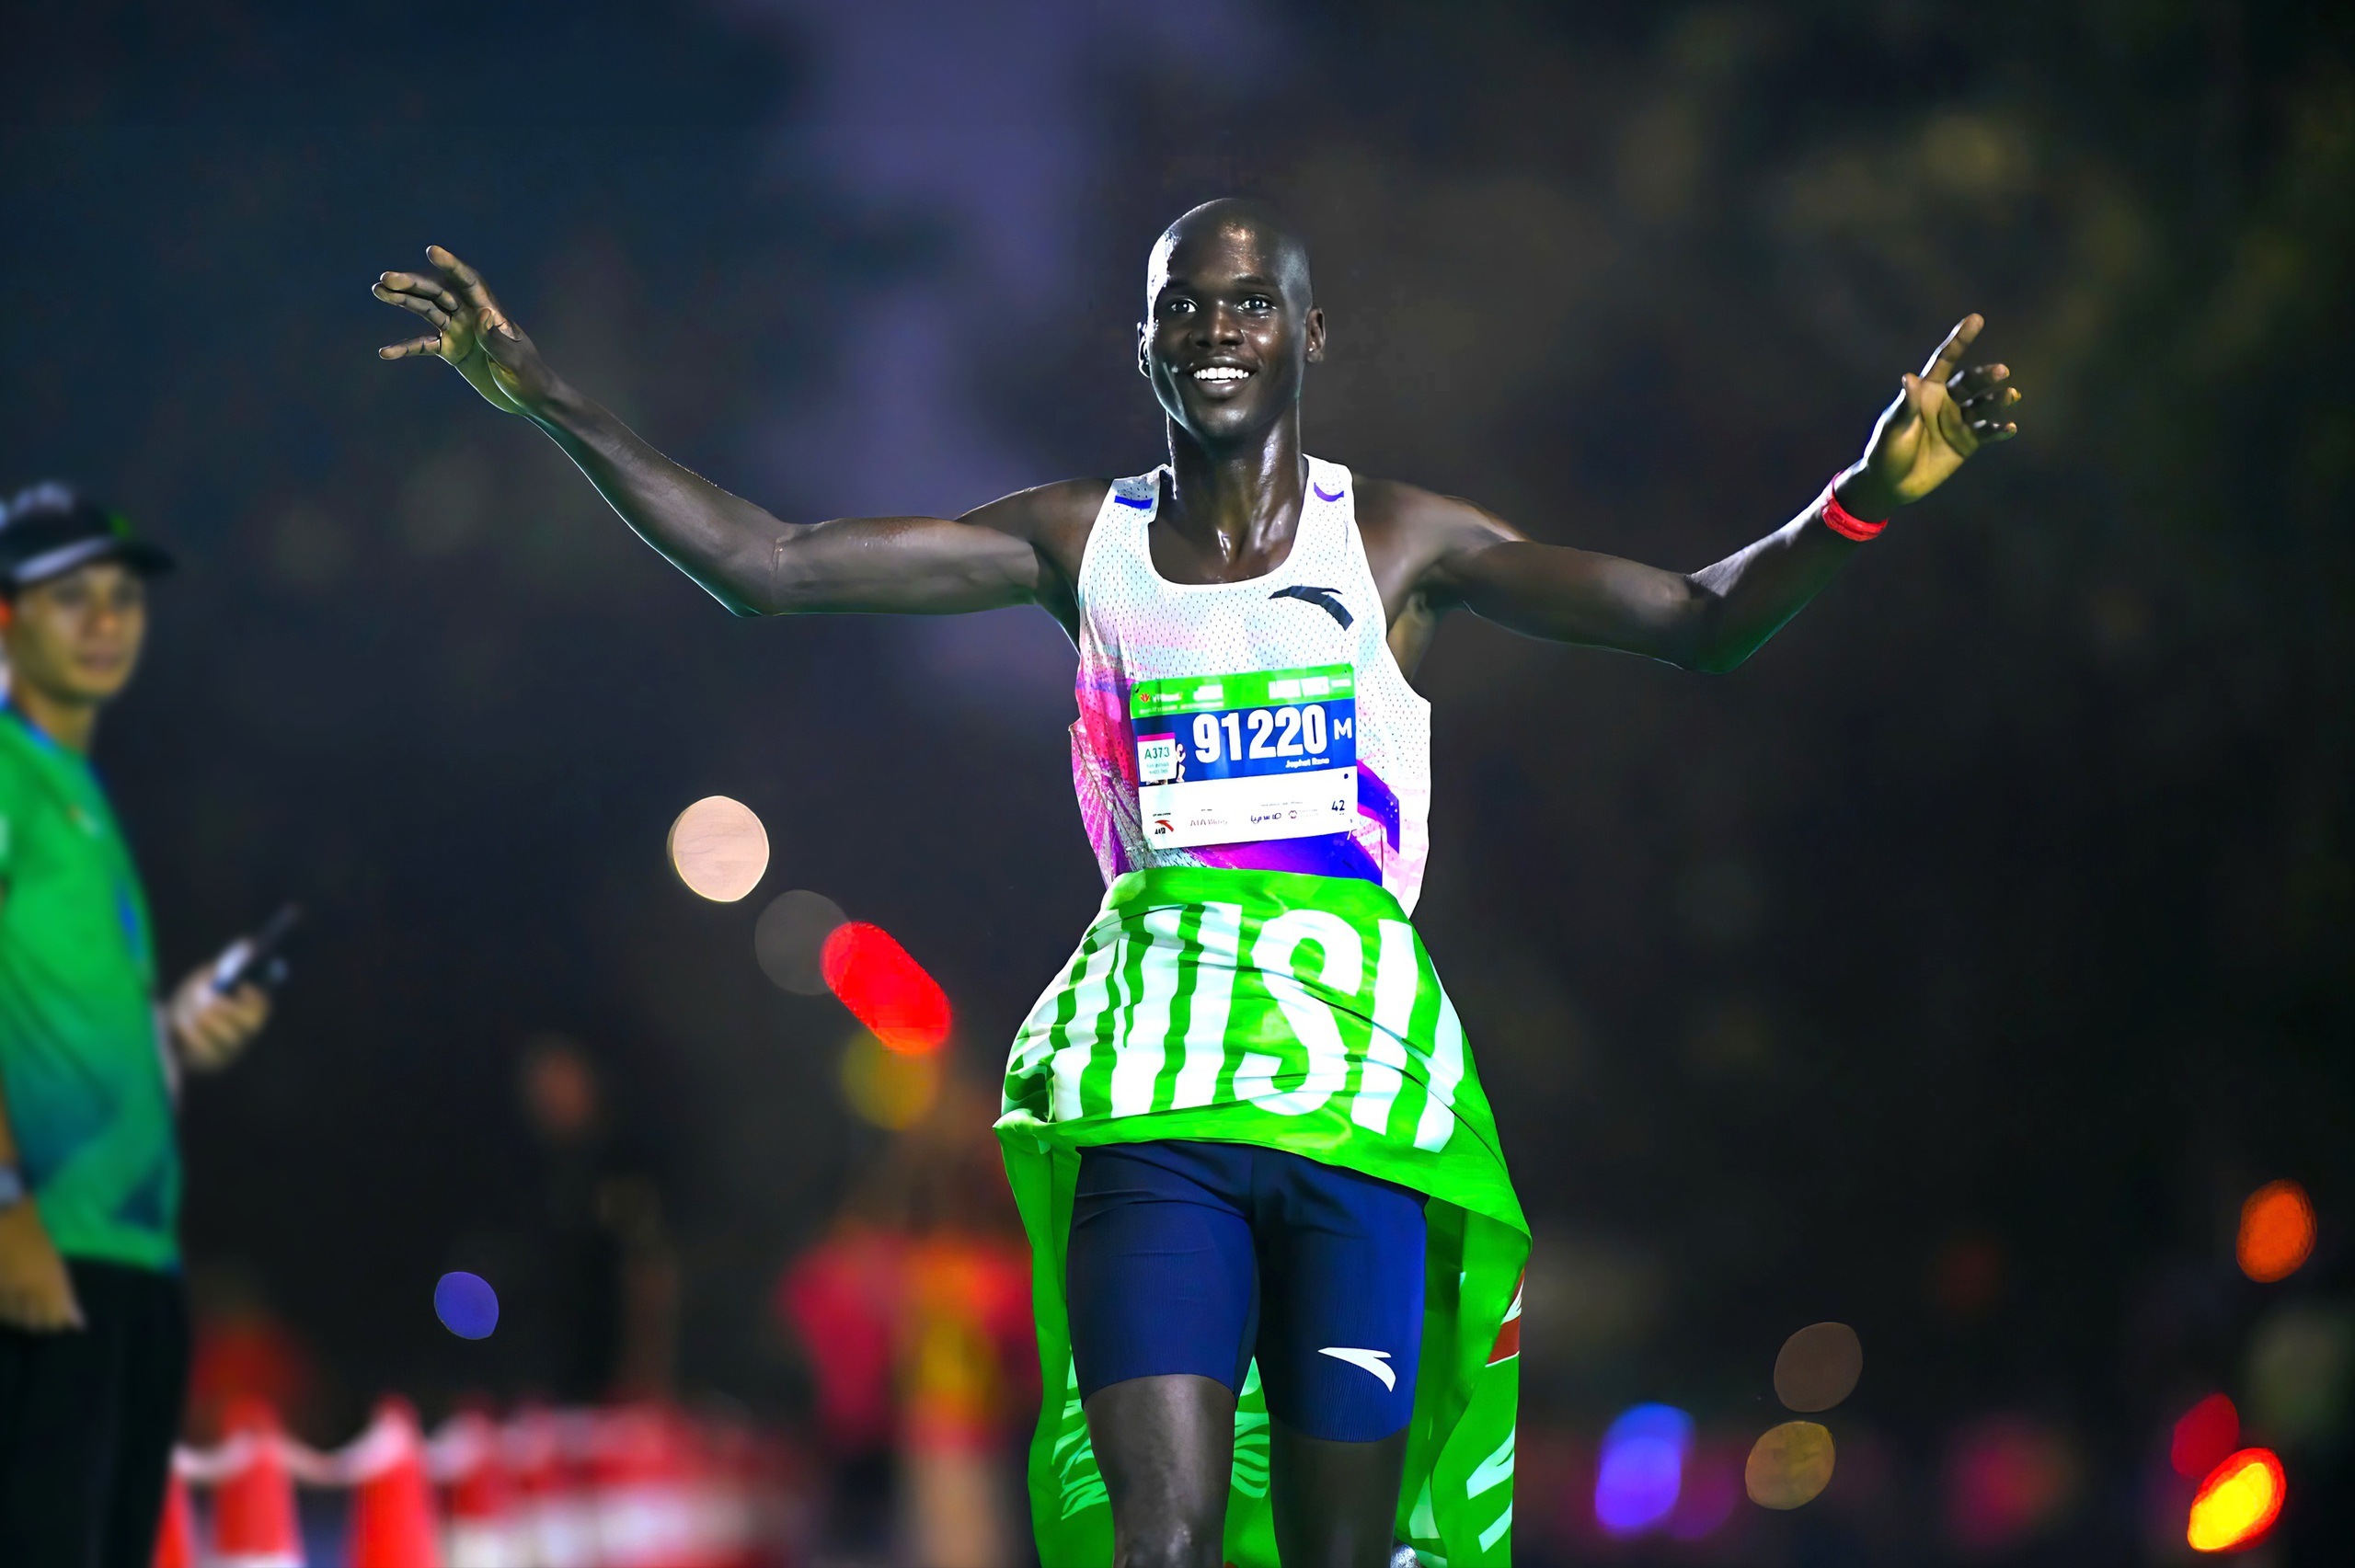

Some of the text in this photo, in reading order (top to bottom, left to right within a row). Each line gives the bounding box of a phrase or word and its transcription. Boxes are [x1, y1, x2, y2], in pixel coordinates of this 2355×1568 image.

[1192, 704, 1352, 763] 91220 M
[1143, 746, 1170, 760] A373
[1331, 799, 1345, 811] 42
